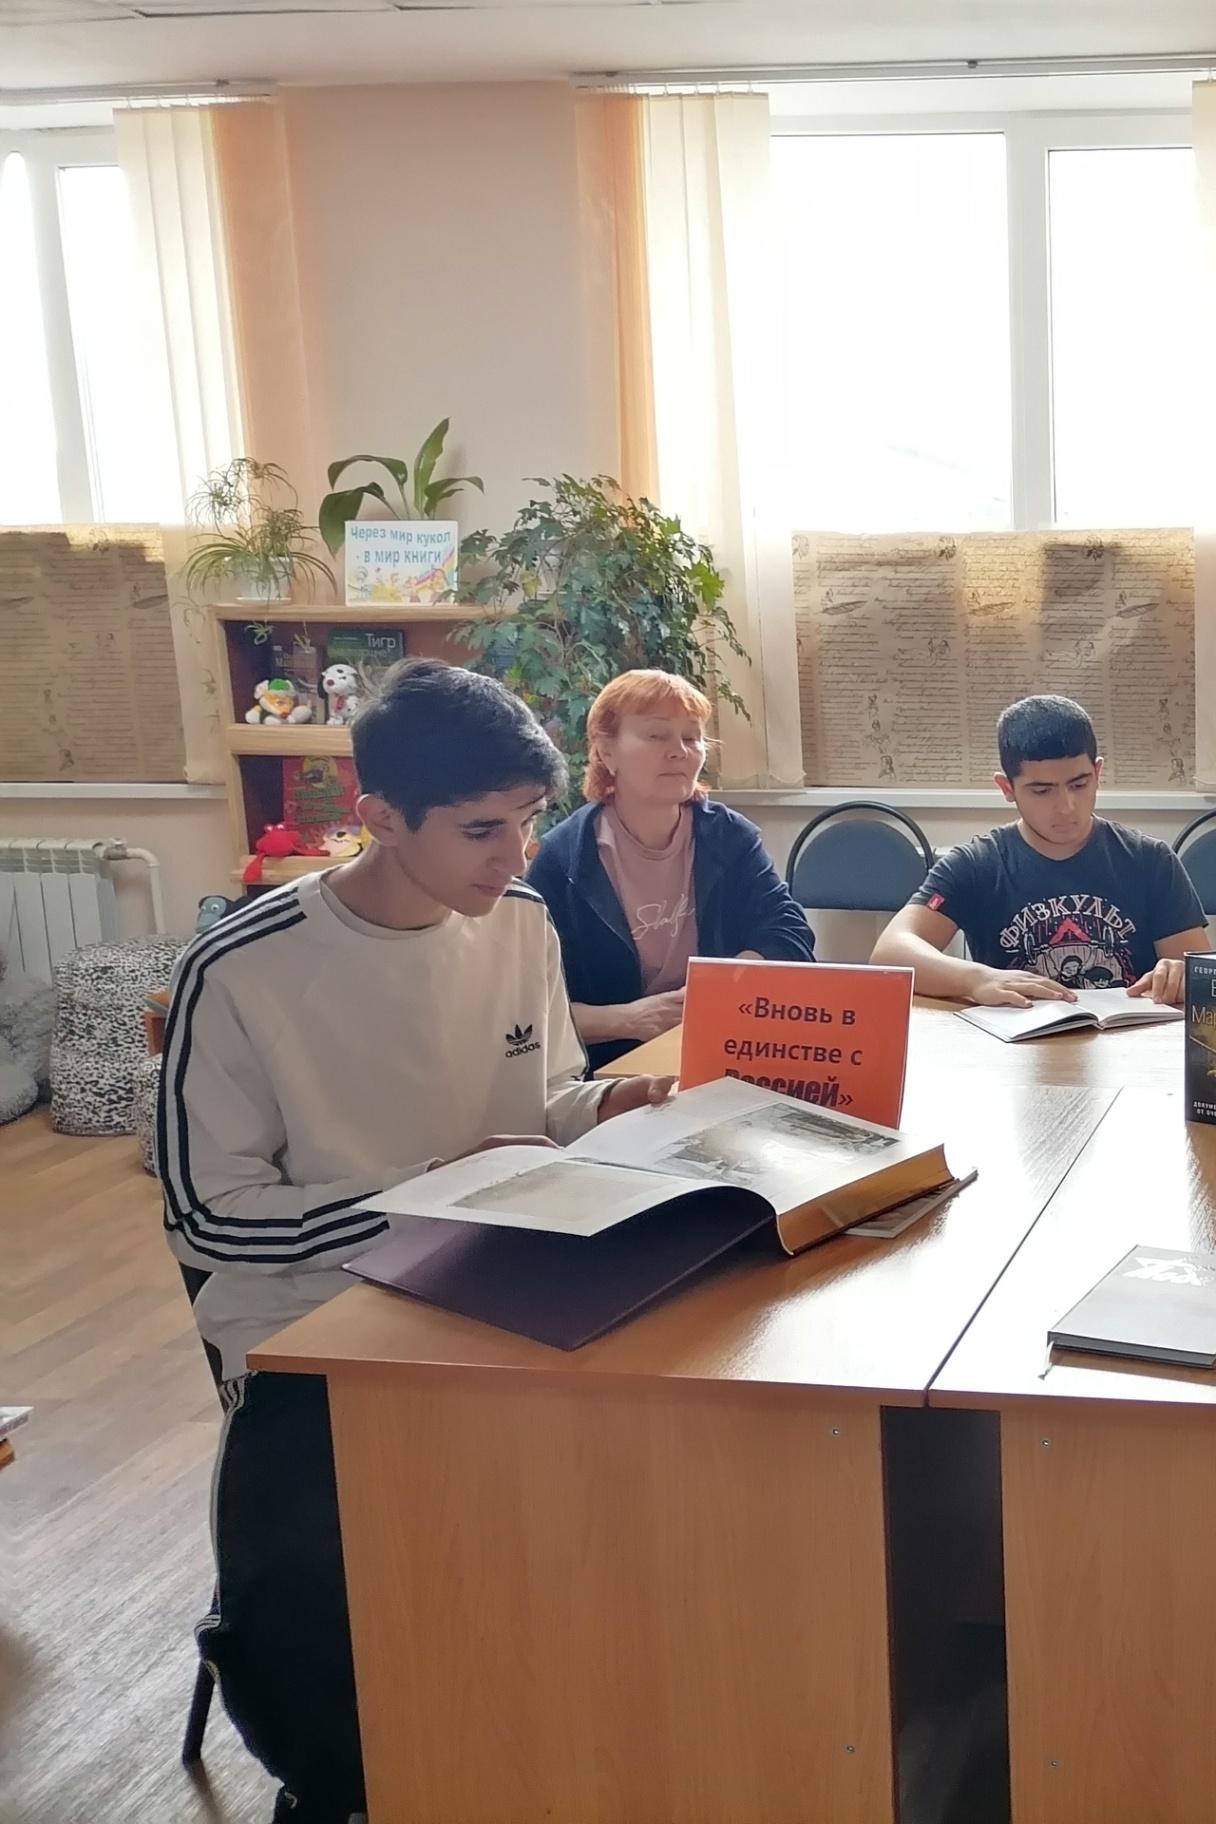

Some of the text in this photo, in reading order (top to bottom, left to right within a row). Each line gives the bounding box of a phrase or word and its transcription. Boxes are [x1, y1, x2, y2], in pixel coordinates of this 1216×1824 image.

[350, 526, 451, 547] Через мир кукол
[364, 550, 441, 567] в мир книги
[364, 632, 396, 653] Тигр
[738, 996, 856, 1026] «Вновь в
[505, 1041, 541, 1058] adidas
[723, 1038, 863, 1066] единстве с
